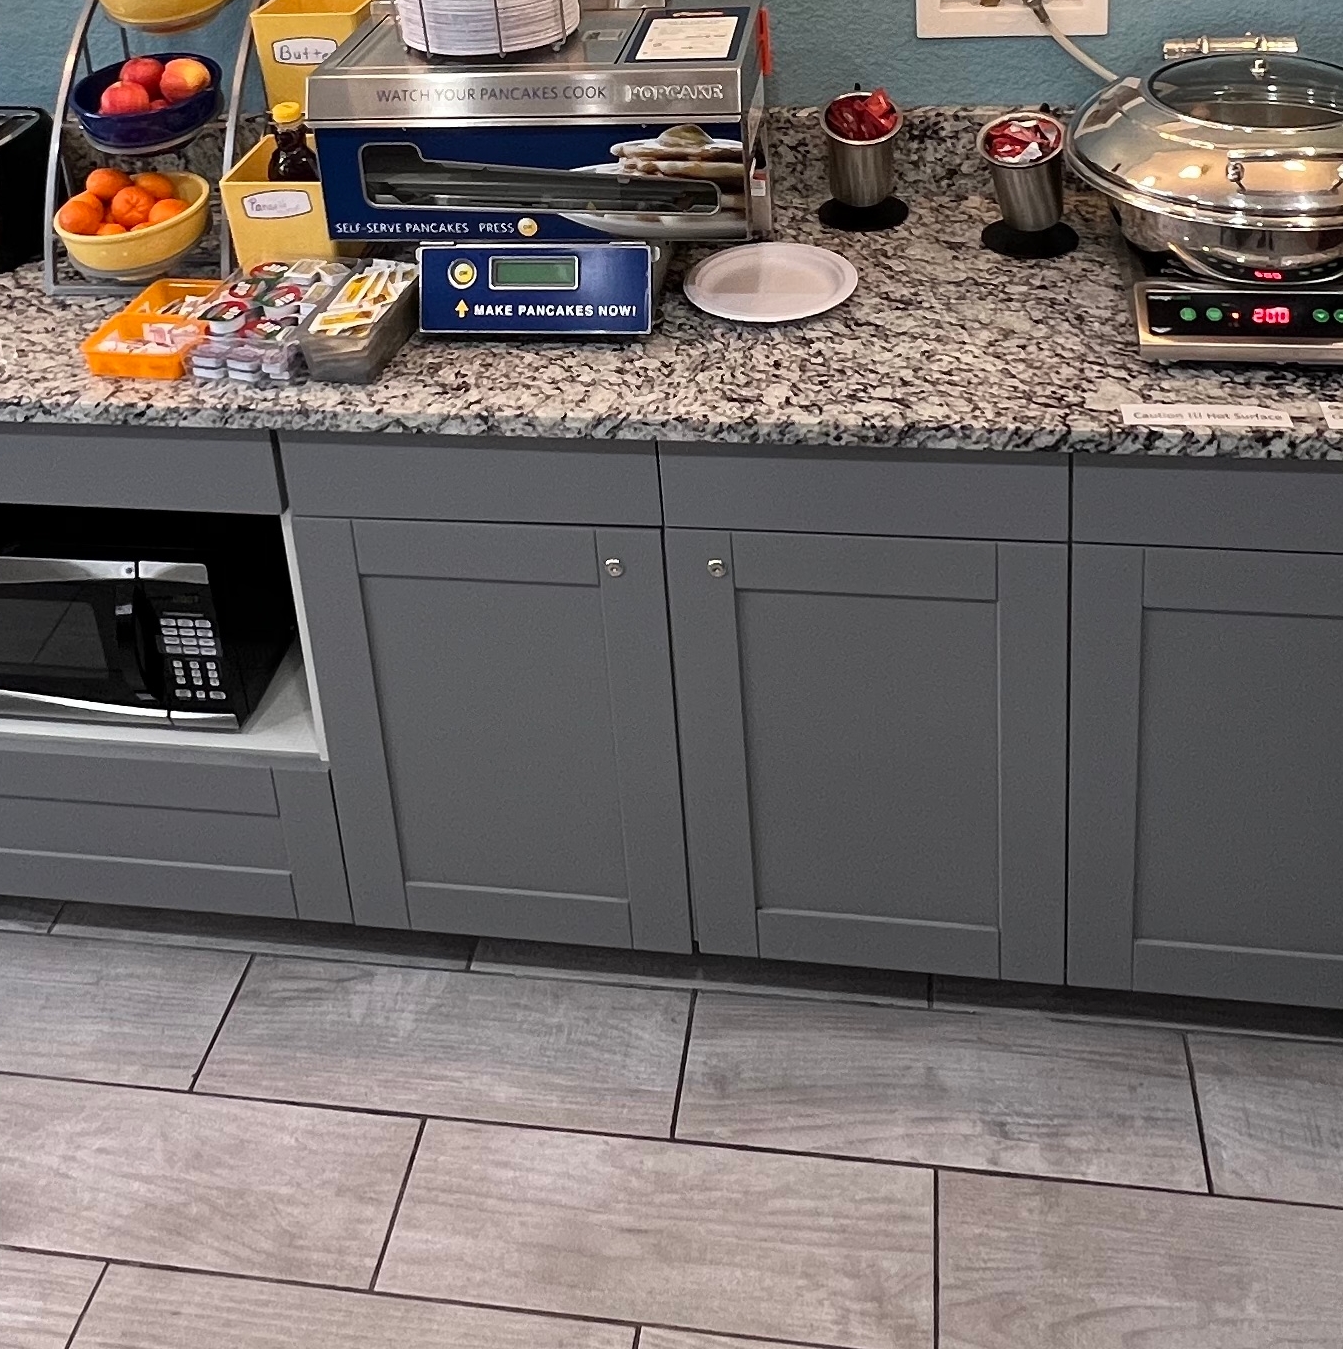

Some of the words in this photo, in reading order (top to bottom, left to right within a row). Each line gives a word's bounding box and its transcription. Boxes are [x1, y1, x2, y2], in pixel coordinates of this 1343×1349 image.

[279, 44, 329, 61] Butte
[376, 87, 430, 102] WATCH
[434, 86, 476, 102] YOUR
[480, 85, 558, 101] PANCAKES
[562, 84, 607, 99] COOK
[335, 222, 402, 234] SELF-SERVE
[405, 222, 470, 234] PANCAKES
[478, 222, 515, 234] PRESS
[473, 303, 513, 317] MAKE
[517, 304, 594, 318] PANCAKES
[597, 305, 637, 318] NOW!
[1252, 306, 1291, 325] 200
[1133, 410, 1185, 421] Caution
[1206, 411, 1231, 421] Hot
[1234, 411, 1283, 422] Surface
